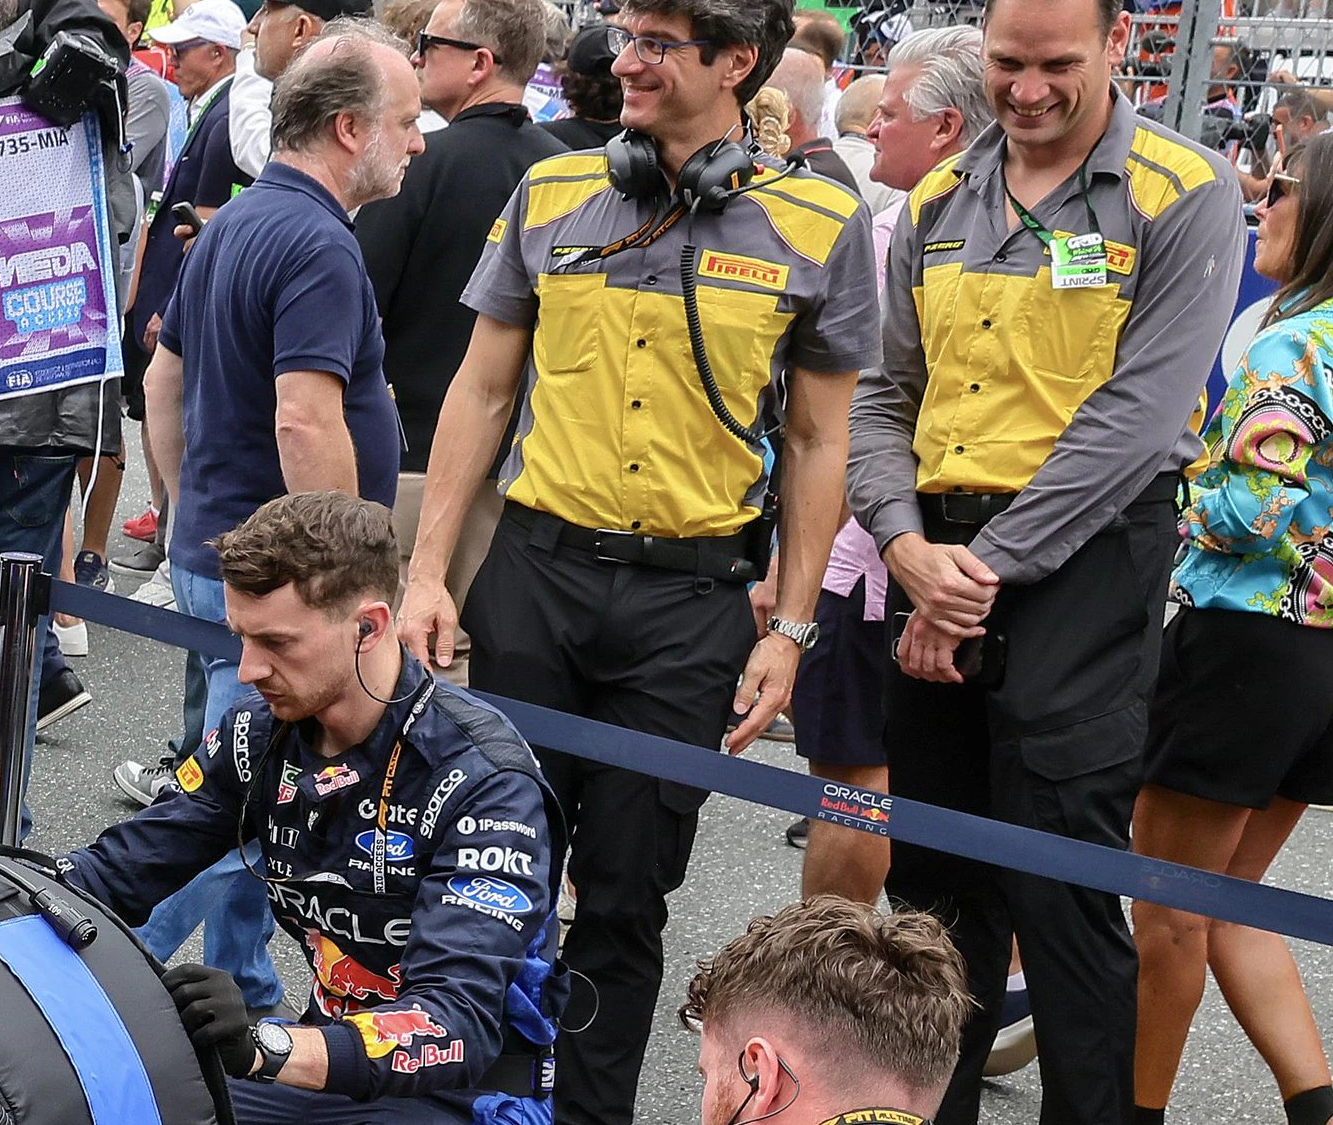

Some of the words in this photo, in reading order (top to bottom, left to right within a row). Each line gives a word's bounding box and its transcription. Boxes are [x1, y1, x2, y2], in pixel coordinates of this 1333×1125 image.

[706, 256, 780, 284] PIRELLI
[6, 280, 86, 318] COURSE
[233, 711, 252, 783] sparco
[315, 779, 338, 796] Red
[336, 770, 360, 790] Bull
[823, 783, 894, 810] ORACLE
[420, 768, 468, 839] sparco
[821, 796, 840, 810] Red
[840, 800, 860, 814] Bull
[477, 817, 538, 839] 1Password
[817, 810, 888, 836] RACING
[375, 838, 385, 872] ACCESS
[456, 847, 534, 876] ROKT
[461, 880, 516, 910] Ford
[46, 903, 62, 917] 109
[441, 894, 524, 932] RACING
[425, 1038, 464, 1067] Bull
[844, 1110, 875, 1125] PIT
[877, 1111, 896, 1123] ALL
